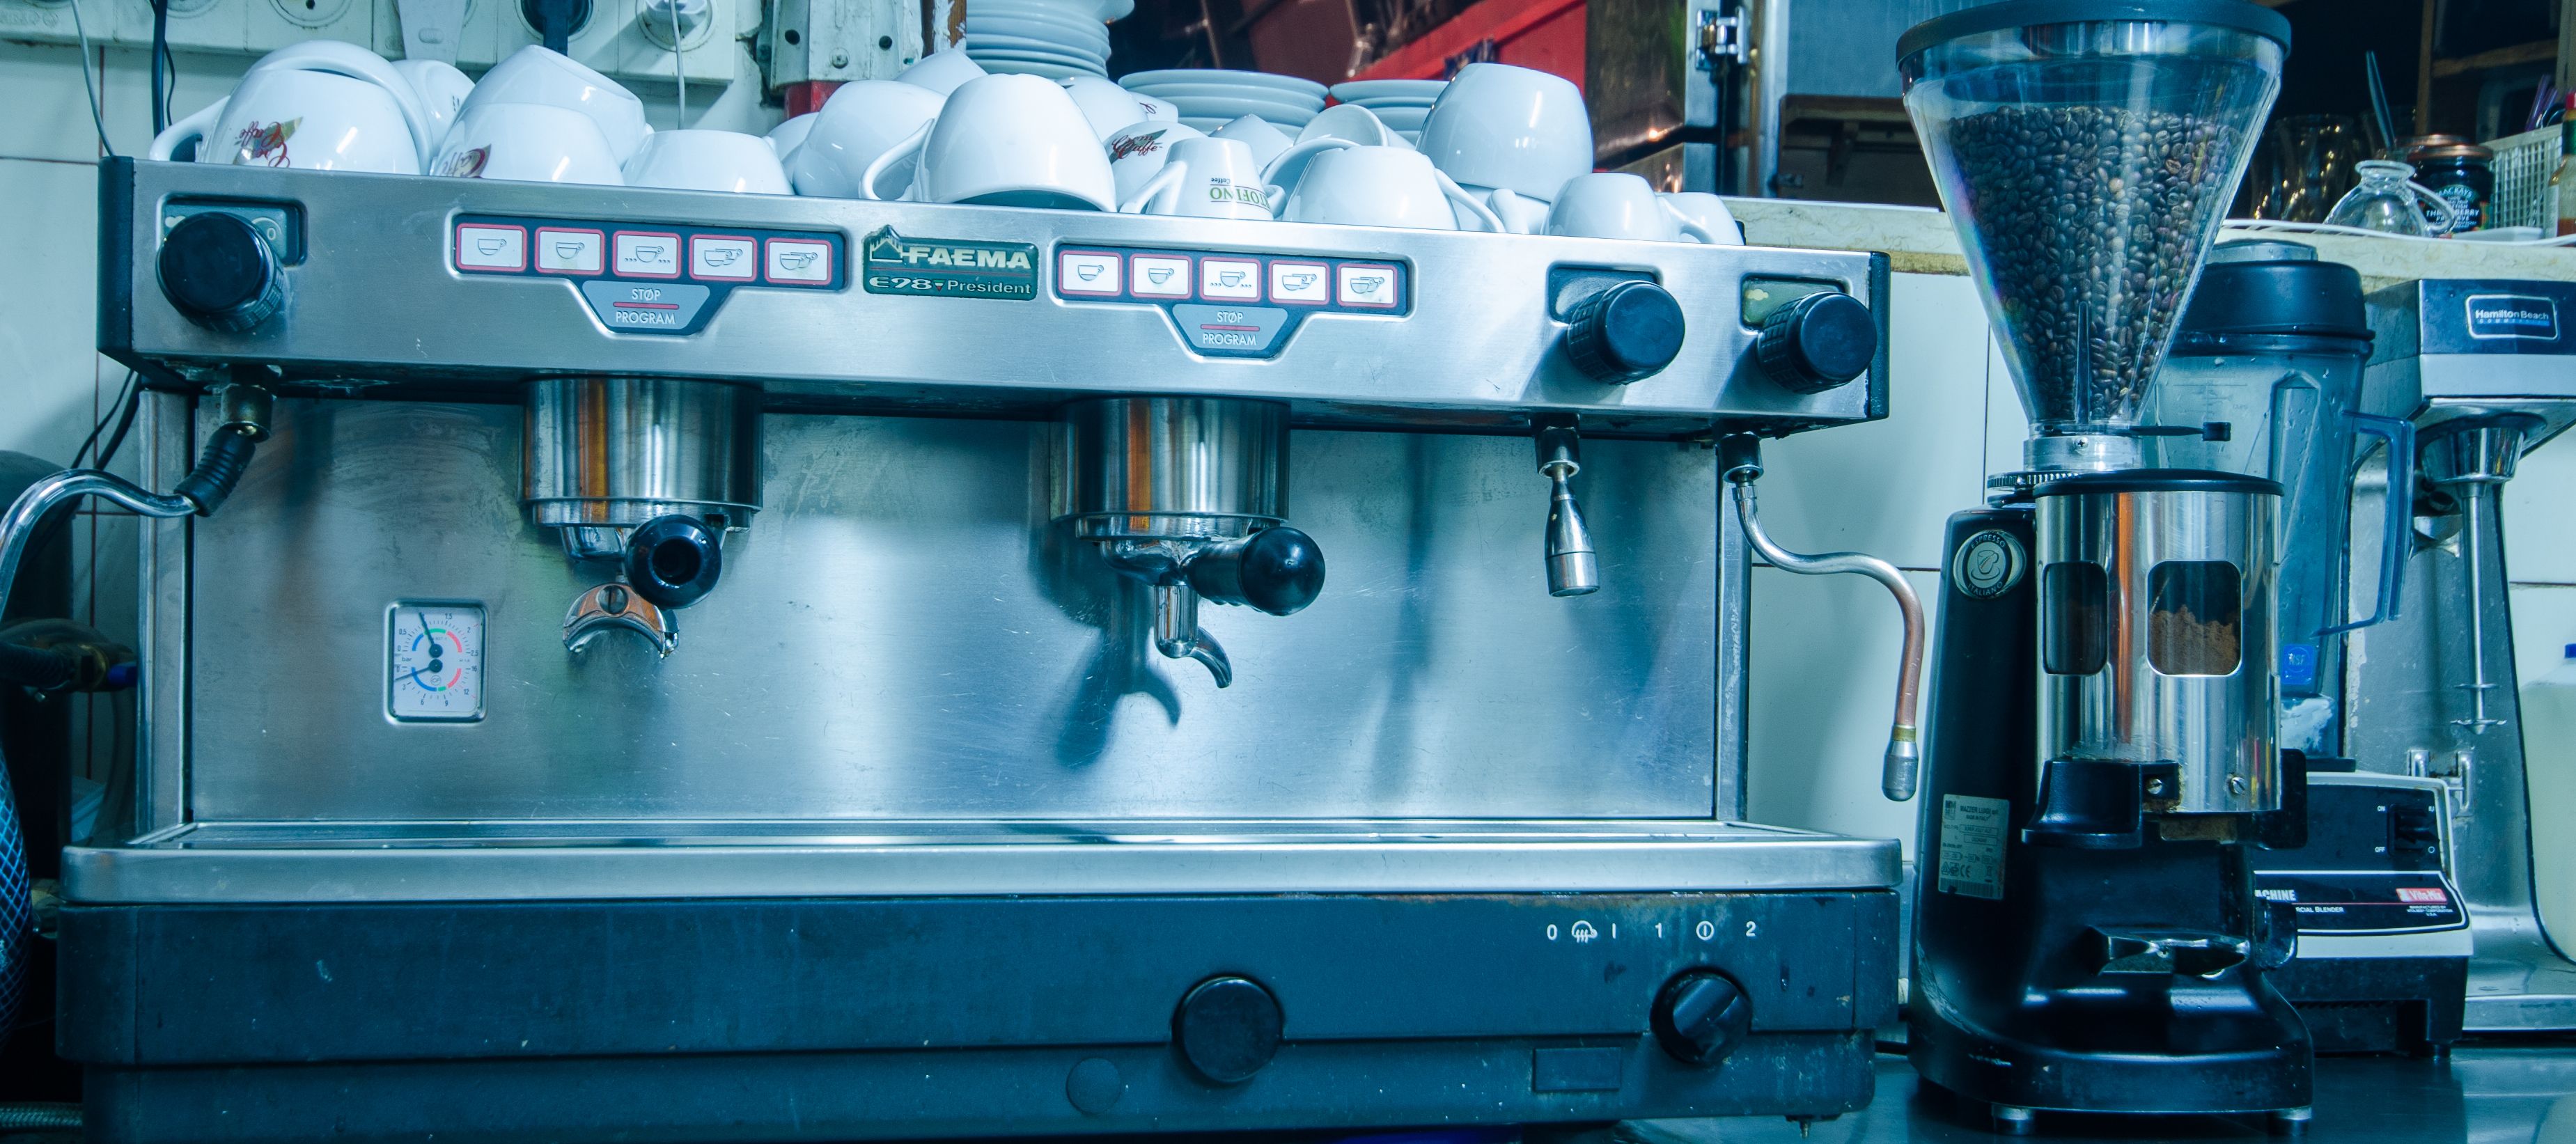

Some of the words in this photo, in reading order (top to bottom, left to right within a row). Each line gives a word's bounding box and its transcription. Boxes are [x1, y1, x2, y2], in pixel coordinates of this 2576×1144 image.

[908, 246, 1031, 269] FAEMA
[946, 279, 1031, 294] President
[616, 311, 676, 324] PROGRAM
[2475, 309, 2520, 319] Hamilton
[2520, 311, 2549, 320] Beach
[1203, 333, 1257, 345] PROGRAM
[1971, 534, 2006, 549] ESPRESSO
[1968, 581, 2003, 595] ITALIANO
[2255, 890, 2296, 901] ACHINE
[1746, 921, 1756, 937] 2
